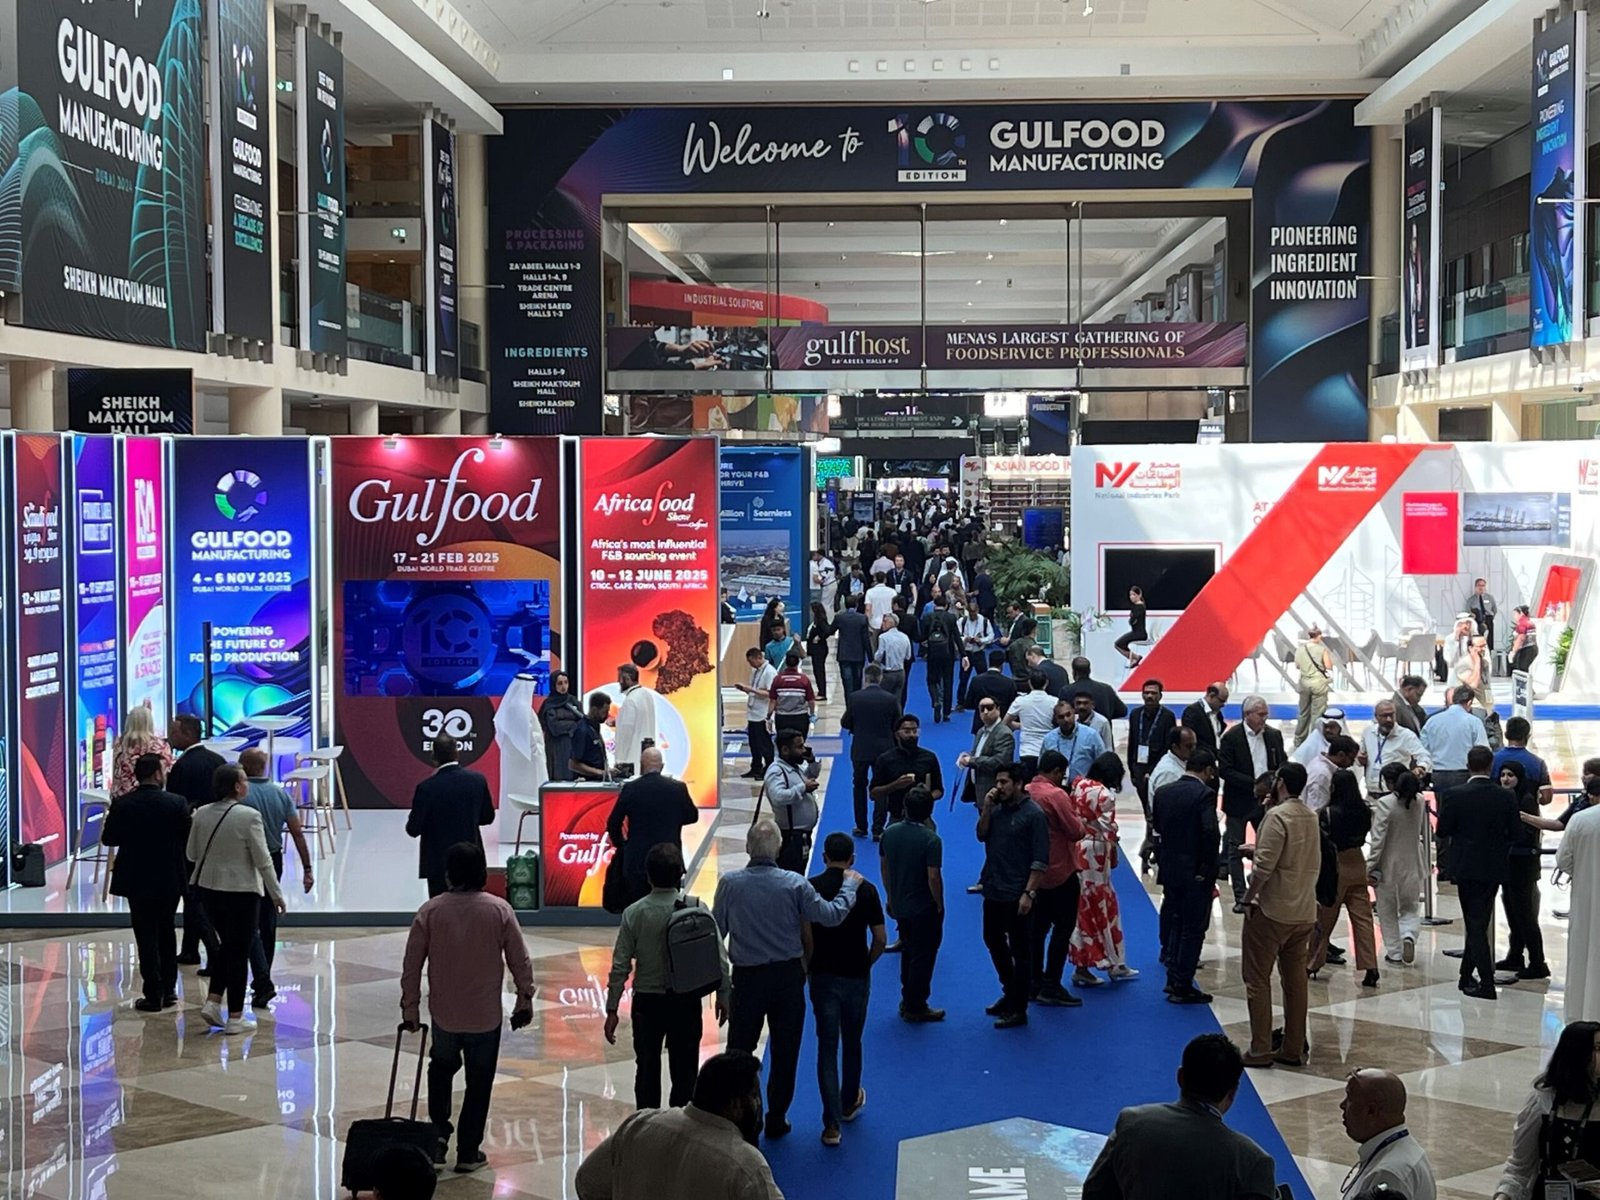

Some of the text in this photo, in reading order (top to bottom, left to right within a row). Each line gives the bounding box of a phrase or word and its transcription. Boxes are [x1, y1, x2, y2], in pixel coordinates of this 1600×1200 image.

[58, 18, 162, 120] GULFOOD
[58, 94, 162, 170] MANUFACTURING
[990, 120, 1166, 150] GULFOOD
[683, 122, 864, 176] Welcome to
[990, 152, 1165, 172] MANUFACTURING
[906, 172, 960, 180] EDITION
[506, 230, 584, 240] PROCESSING
[1270, 226, 1358, 246] PIONEERING
[517, 240, 584, 250] PACKAGING
[1271, 253, 1358, 273] INGREDIENT
[64, 266, 167, 309] SHEIKH MAKTOUM HALL
[1270, 280, 1357, 300] INNOVATION
[684, 293, 764, 311] INDUSTRIAL SOLUTIONS
[946, 331, 1186, 345] MENA'S LARGEST GATHERING OF
[505, 348, 588, 358] INGREDIENTS
[946, 346, 1186, 360] FOODSERVICE PROFESSIONALS
[102, 396, 160, 409] SHEIKH
[88, 411, 174, 424] MAKTOUM
[994, 461, 1060, 470] ASIAN FOOD
[349, 448, 542, 546] Gulfood
[754, 508, 792, 517] Seamless
[1253, 502, 1268, 512] AT
[191, 530, 292, 548] GULFOOD
[591, 539, 708, 549] Africa's most influential
[192, 549, 292, 560] MANUFACTURING
[392, 553, 406, 564] 17
[420, 553, 434, 564] 21
[438, 553, 464, 564] FEB
[468, 553, 500, 564] 2025
[602, 551, 697, 563] F&B sourcing event
[192, 573, 201, 584] 4
[214, 573, 224, 584] 6
[226, 572, 256, 583] NOV
[258, 572, 292, 582] 2025
[590, 570, 605, 580] 10
[619, 570, 634, 580] 12
[636, 570, 672, 580] JUNE
[675, 570, 708, 580] 2025
[212, 626, 274, 636] POWERING
[210, 638, 286, 649] HE FUTURE OF
[224, 651, 300, 662] PRODUCTION
[422, 708, 472, 738] 30
[590, 832, 599, 841] by
